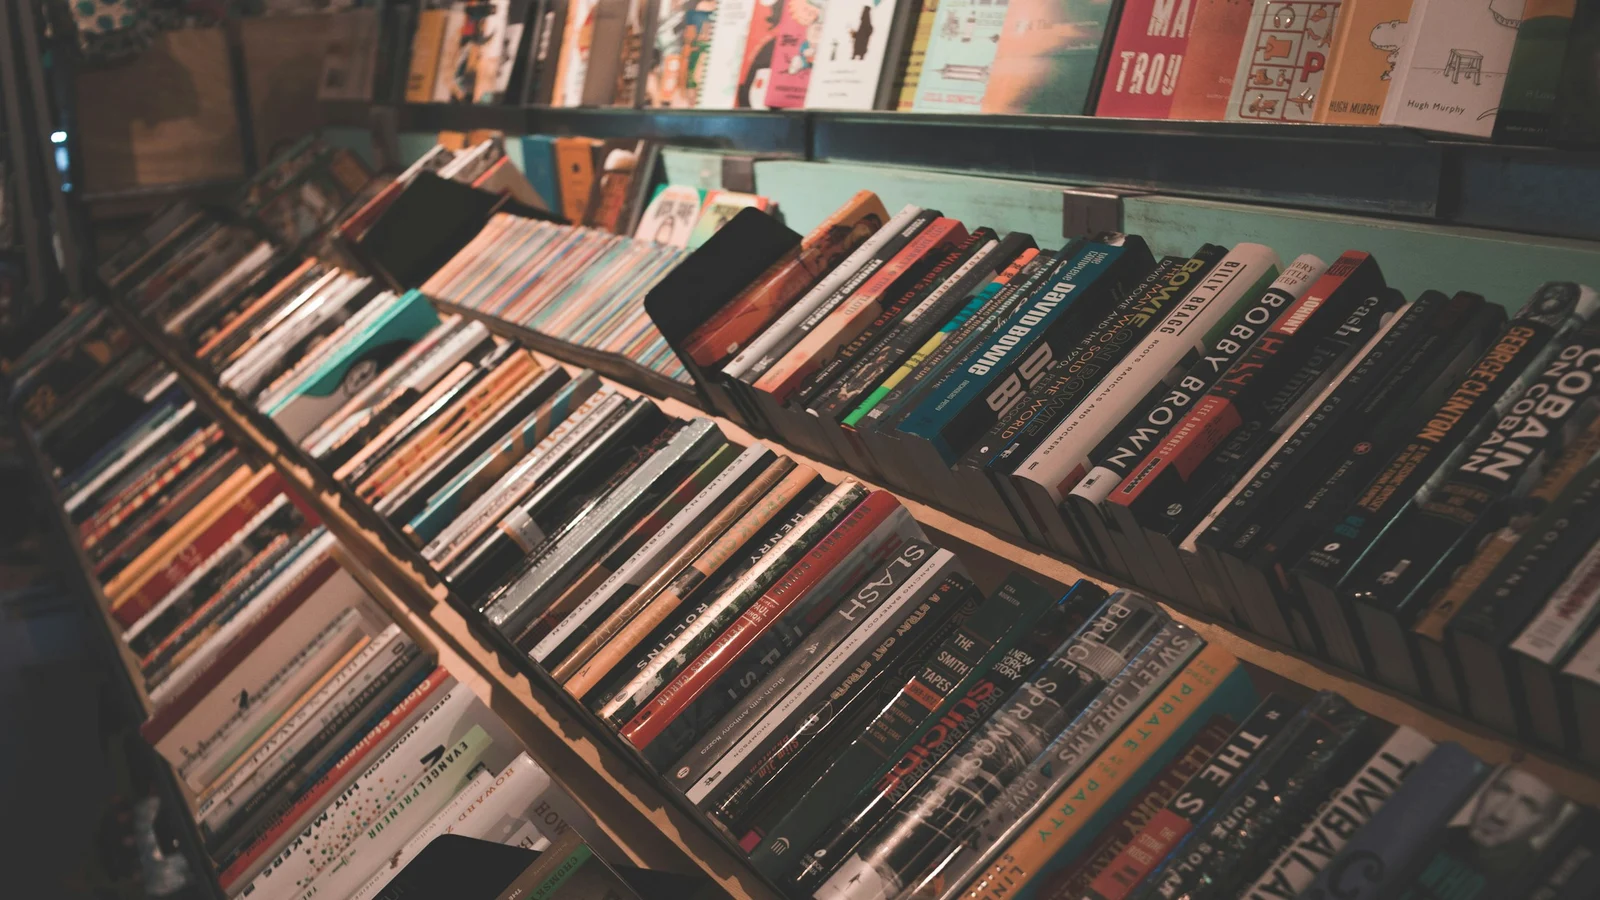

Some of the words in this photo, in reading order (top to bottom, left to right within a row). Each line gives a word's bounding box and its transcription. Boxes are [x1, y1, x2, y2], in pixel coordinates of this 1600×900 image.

[1329, 100, 1348, 112] HUGH
[1350, 101, 1380, 116] MURPHY
[1407, 100, 1429, 110] Hugh
[1433, 101, 1466, 115] Murphy
[958, 228, 984, 248] This
[842, 259, 882, 294] FINDING
[914, 252, 962, 290] Wheel's
[963, 251, 986, 270] SARA
[1031, 268, 1047, 279] THE
[1045, 258, 1056, 266] IN
[1146, 260, 1172, 282] DAVID
[1161, 264, 1183, 281] THE
[1202, 261, 1241, 291] BILLY
[898, 292, 914, 304] on
[985, 285, 1018, 314] THROWING
[1119, 283, 1148, 309] BOWIE
[1127, 258, 1205, 328] BOWIE
[1132, 283, 1163, 310] MAN
[808, 295, 842, 325] JOSEPH
[874, 306, 901, 326] Fire
[1098, 310, 1118, 329] AND
[1160, 296, 1206, 334] BRAGG
[1280, 296, 1322, 334] JOHNNY
[1335, 297, 1378, 336] cash
[1384, 299, 1429, 346] JOHNNY
[868, 329, 900, 356] SOUNDS
[952, 316, 984, 344] FRISBEES
[1082, 331, 1099, 345] THE
[1100, 314, 1134, 342] WHO
[1204, 292, 1285, 372] BOBBY
[929, 354, 944, 366] THE
[942, 345, 953, 353] AT
[1056, 347, 1083, 369] 1970s
[1069, 345, 1101, 373] SOLD
[1093, 329, 1133, 361] ON
[1133, 339, 1160, 362] ROOTS,
[1470, 327, 1534, 382] GEORGE
[1544, 345, 1583, 377] ON
[837, 375, 849, 384] ME
[850, 358, 868, 372] LIKE
[914, 366, 931, 380] SUN
[1265, 348, 1336, 412] johnny
[1349, 351, 1383, 383] CASH
[1032, 374, 1056, 395] PETER
[1044, 376, 1071, 396] THE
[1096, 366, 1133, 402] RADICALS
[990, 396, 1032, 435] DOGGETT
[1001, 399, 1048, 439] WORLD
[1019, 372, 1091, 437] BOWIE
[1078, 404, 1095, 419] AND
[1197, 404, 1213, 416] SEE
[1417, 381, 1487, 442] CLINTON
[1480, 348, 1600, 481] COBAIN
[1043, 421, 1079, 455] ROCKERS
[1107, 376, 1205, 468] BROWN
[1283, 396, 1341, 454] FOREVER
[1460, 383, 1549, 472] COBAIN
[1159, 423, 1195, 455] DARKNESS
[1216, 421, 1261, 463] cash
[685, 453, 750, 513] TESTIMONY
[1235, 461, 1282, 506] WORDS
[630, 522, 674, 564] ROBBIE
[750, 513, 806, 564] HENRY
[812, 506, 871, 558] HOMEWARD
[1496, 518, 1568, 596] COLLINS
[838, 545, 925, 621] SLASH
[903, 563, 936, 594] DANCING
[548, 568, 624, 636] ROBERTSON
[928, 593, 940, 602] A
[864, 596, 902, 632] BAREFOOT
[896, 603, 930, 636] STRAY
[637, 603, 711, 670] ROLLINS
[716, 627, 745, 651] PETER
[844, 638, 858, 650] THE
[872, 637, 896, 660] CAT
[953, 633, 975, 651] THE
[1053, 602, 1131, 674] BRUCE
[1141, 628, 1171, 655] ARE
[628, 648, 673, 686] SIMON
[691, 653, 717, 673] AMES
[825, 652, 844, 669] PATTI
[937, 651, 969, 675] SMITH
[994, 662, 1021, 680] STORY
[1001, 656, 1025, 671] YORK
[1014, 652, 1034, 664] NEW
[1130, 636, 1189, 694] SWEET
[658, 675, 692, 706] CARLIN
[764, 677, 785, 695] Slash
[803, 670, 824, 690] SMITH
[830, 660, 872, 700] STRUTS
[922, 667, 952, 692] TAPES
[1105, 657, 1143, 696] MADE
[388, 680, 431, 715] Gloria
[423, 694, 451, 722] DEREK
[749, 696, 764, 709] with
[782, 691, 802, 712] STORY
[959, 687, 1004, 730] DREAM
[1082, 699, 1102, 717] OF
[722, 710, 748, 735] Anthony
[1059, 694, 1133, 765] DREAMS
[1124, 683, 1193, 752] PIRATE
[331, 718, 390, 768] Steinem
[733, 722, 770, 758] THOMPSON
[774, 738, 797, 757] Slim
[879, 683, 993, 798] SUICIDE
[929, 726, 963, 761] BABY
[1045, 719, 1082, 753] THIS
[364, 726, 418, 779] THOMPSON
[906, 695, 1038, 824] SPRINGSTEEN
[1200, 731, 1267, 786] THE
[758, 760, 776, 778] Jim
[885, 759, 932, 803] DREAM
[331, 783, 359, 810] HIT
[368, 741, 468, 839] EVANGELPRENEUR
[458, 768, 514, 821] HOWARD
[1005, 780, 1037, 811] DAVE
[1256, 780, 1270, 791] A
[1039, 779, 1100, 842] PARTY
[1123, 785, 1180, 838] FURY
[1211, 796, 1256, 839] PURE
[257, 812, 328, 877] MAKERS
